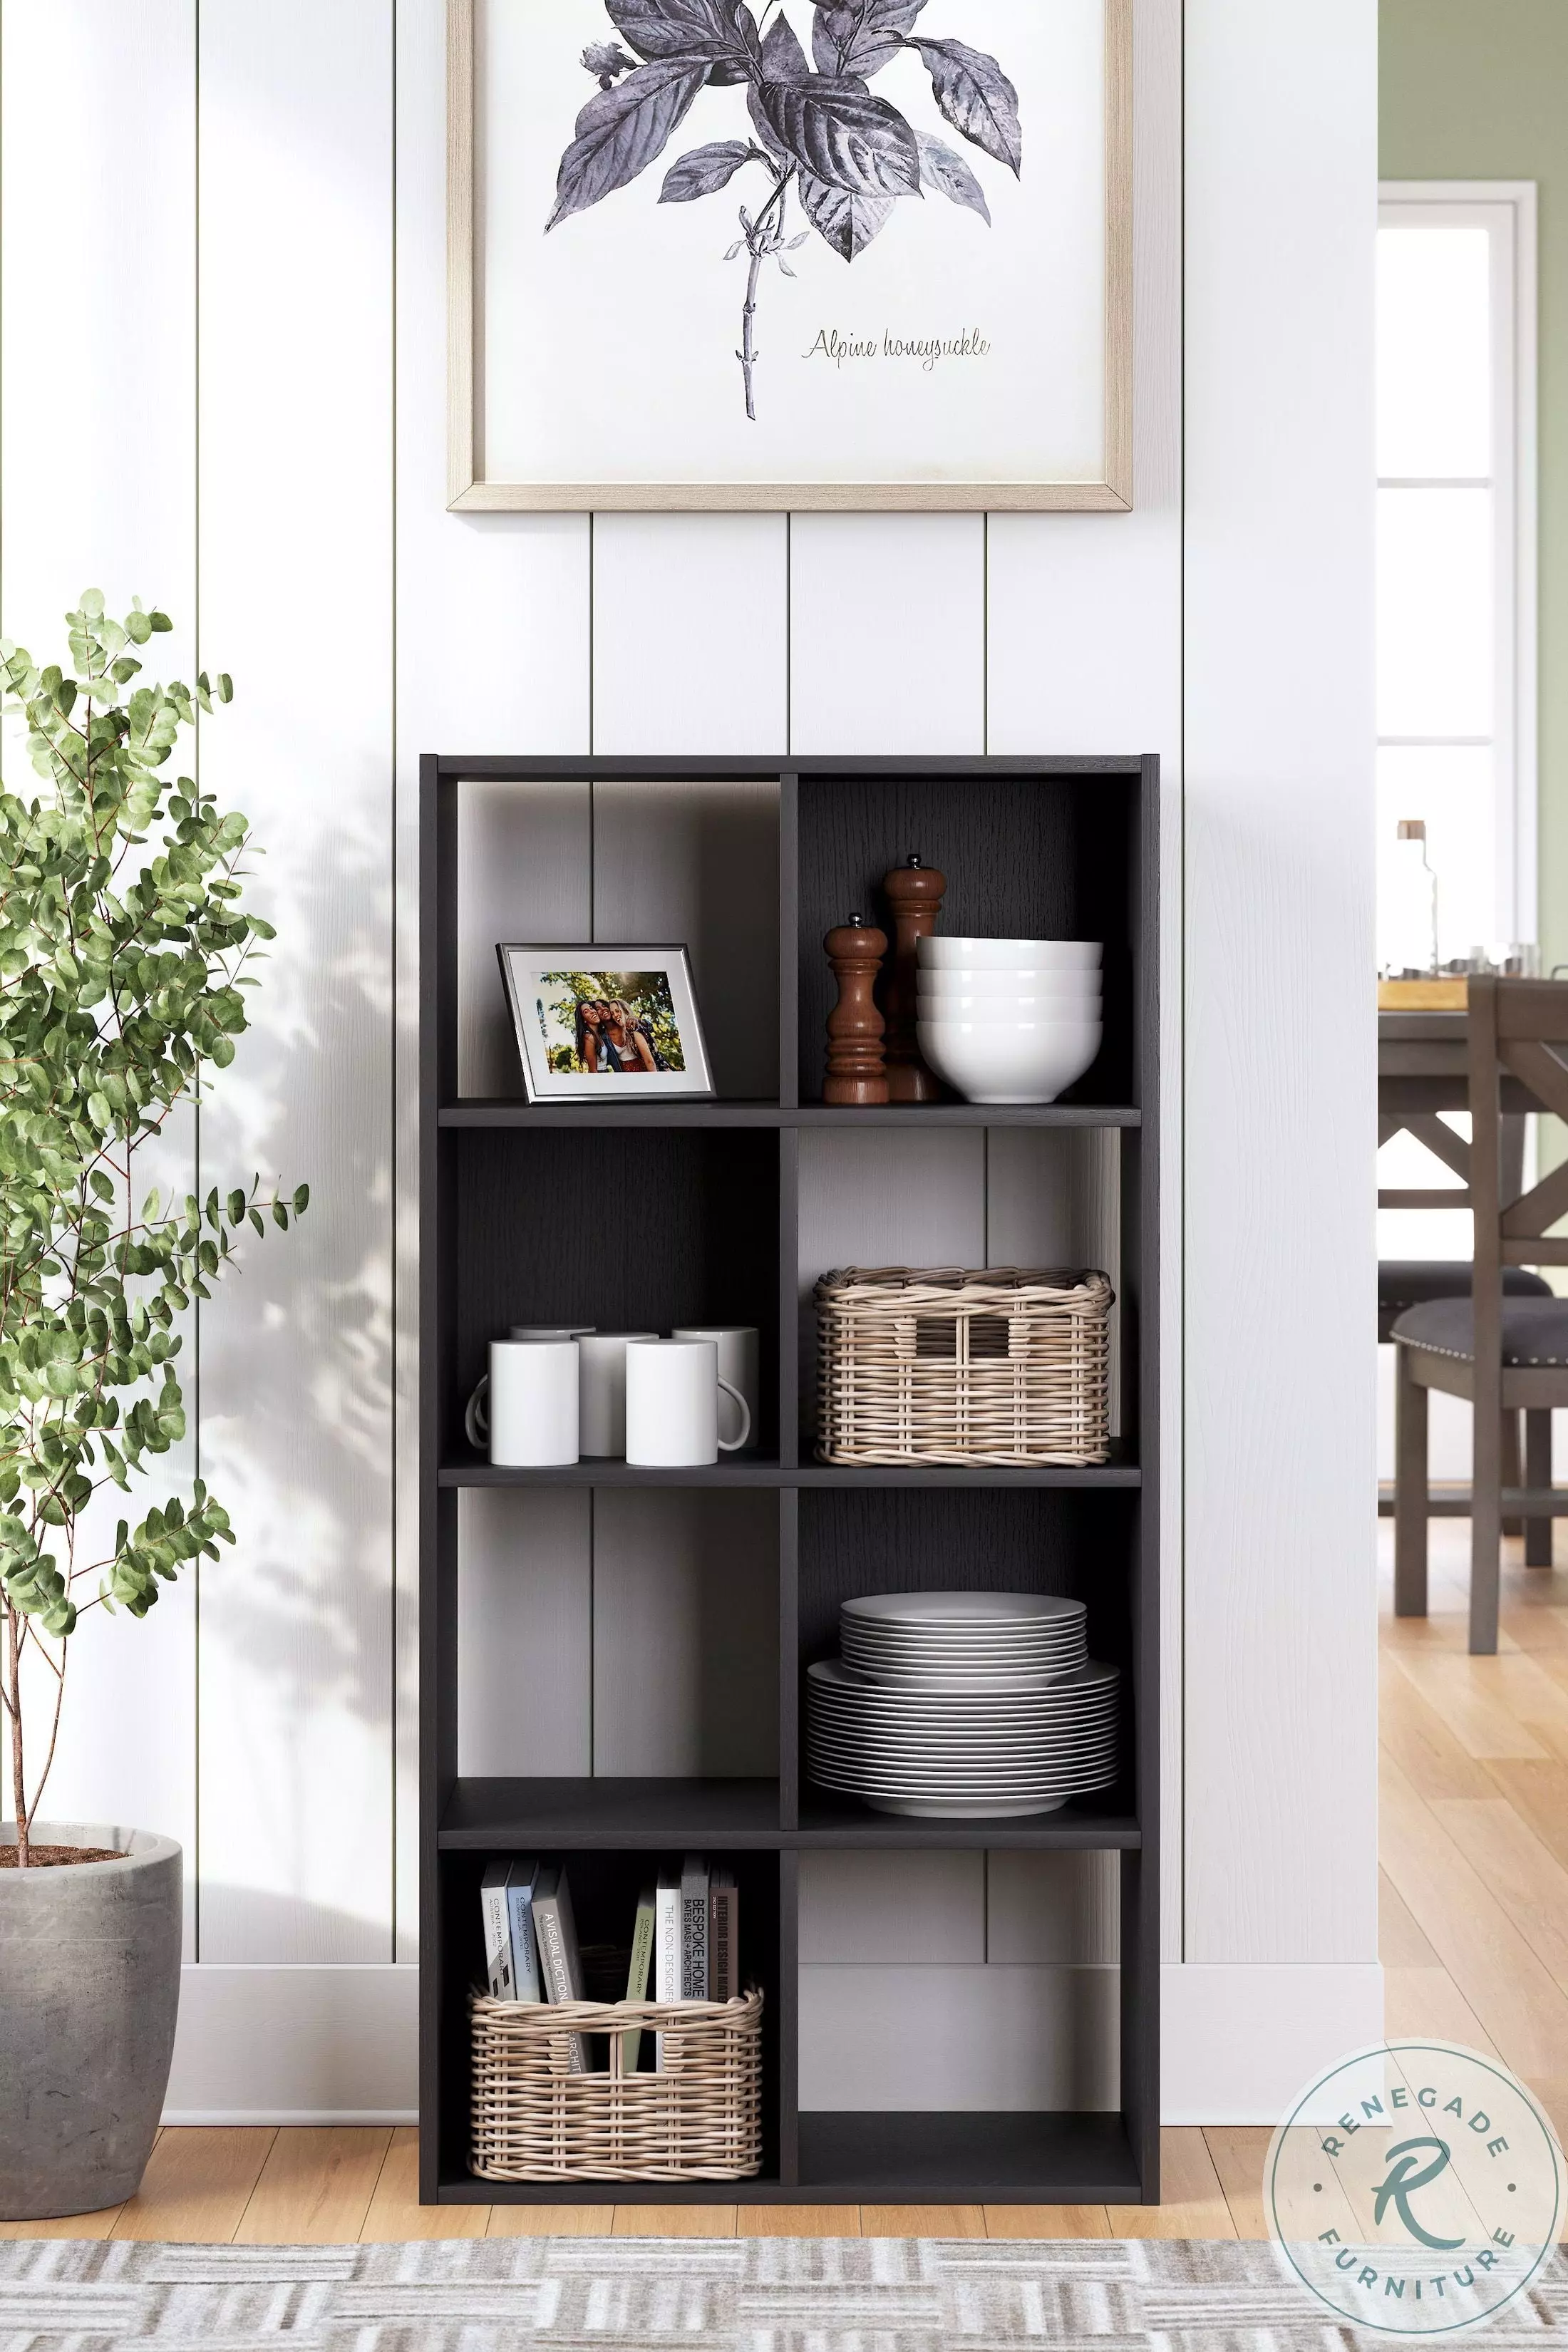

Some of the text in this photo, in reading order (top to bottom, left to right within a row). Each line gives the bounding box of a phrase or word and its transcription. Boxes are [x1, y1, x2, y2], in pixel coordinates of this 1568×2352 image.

[801, 327, 991, 371] Alpine honeysuckle
[520, 1897, 531, 1973] CONTEMPORARY
[542, 1941, 551, 1967] bestselling
[546, 1921, 560, 1957] VISUAL
[553, 1959, 569, 2005] DICTION
[636, 1919, 650, 1994] CONTEMPORARY
[665, 1905, 674, 2003] THE NON-DESIGNER
[693, 1899, 705, 1997] BESPOKE HOME
[718, 1896, 728, 2003] INTERIOR DESIGN MATE
